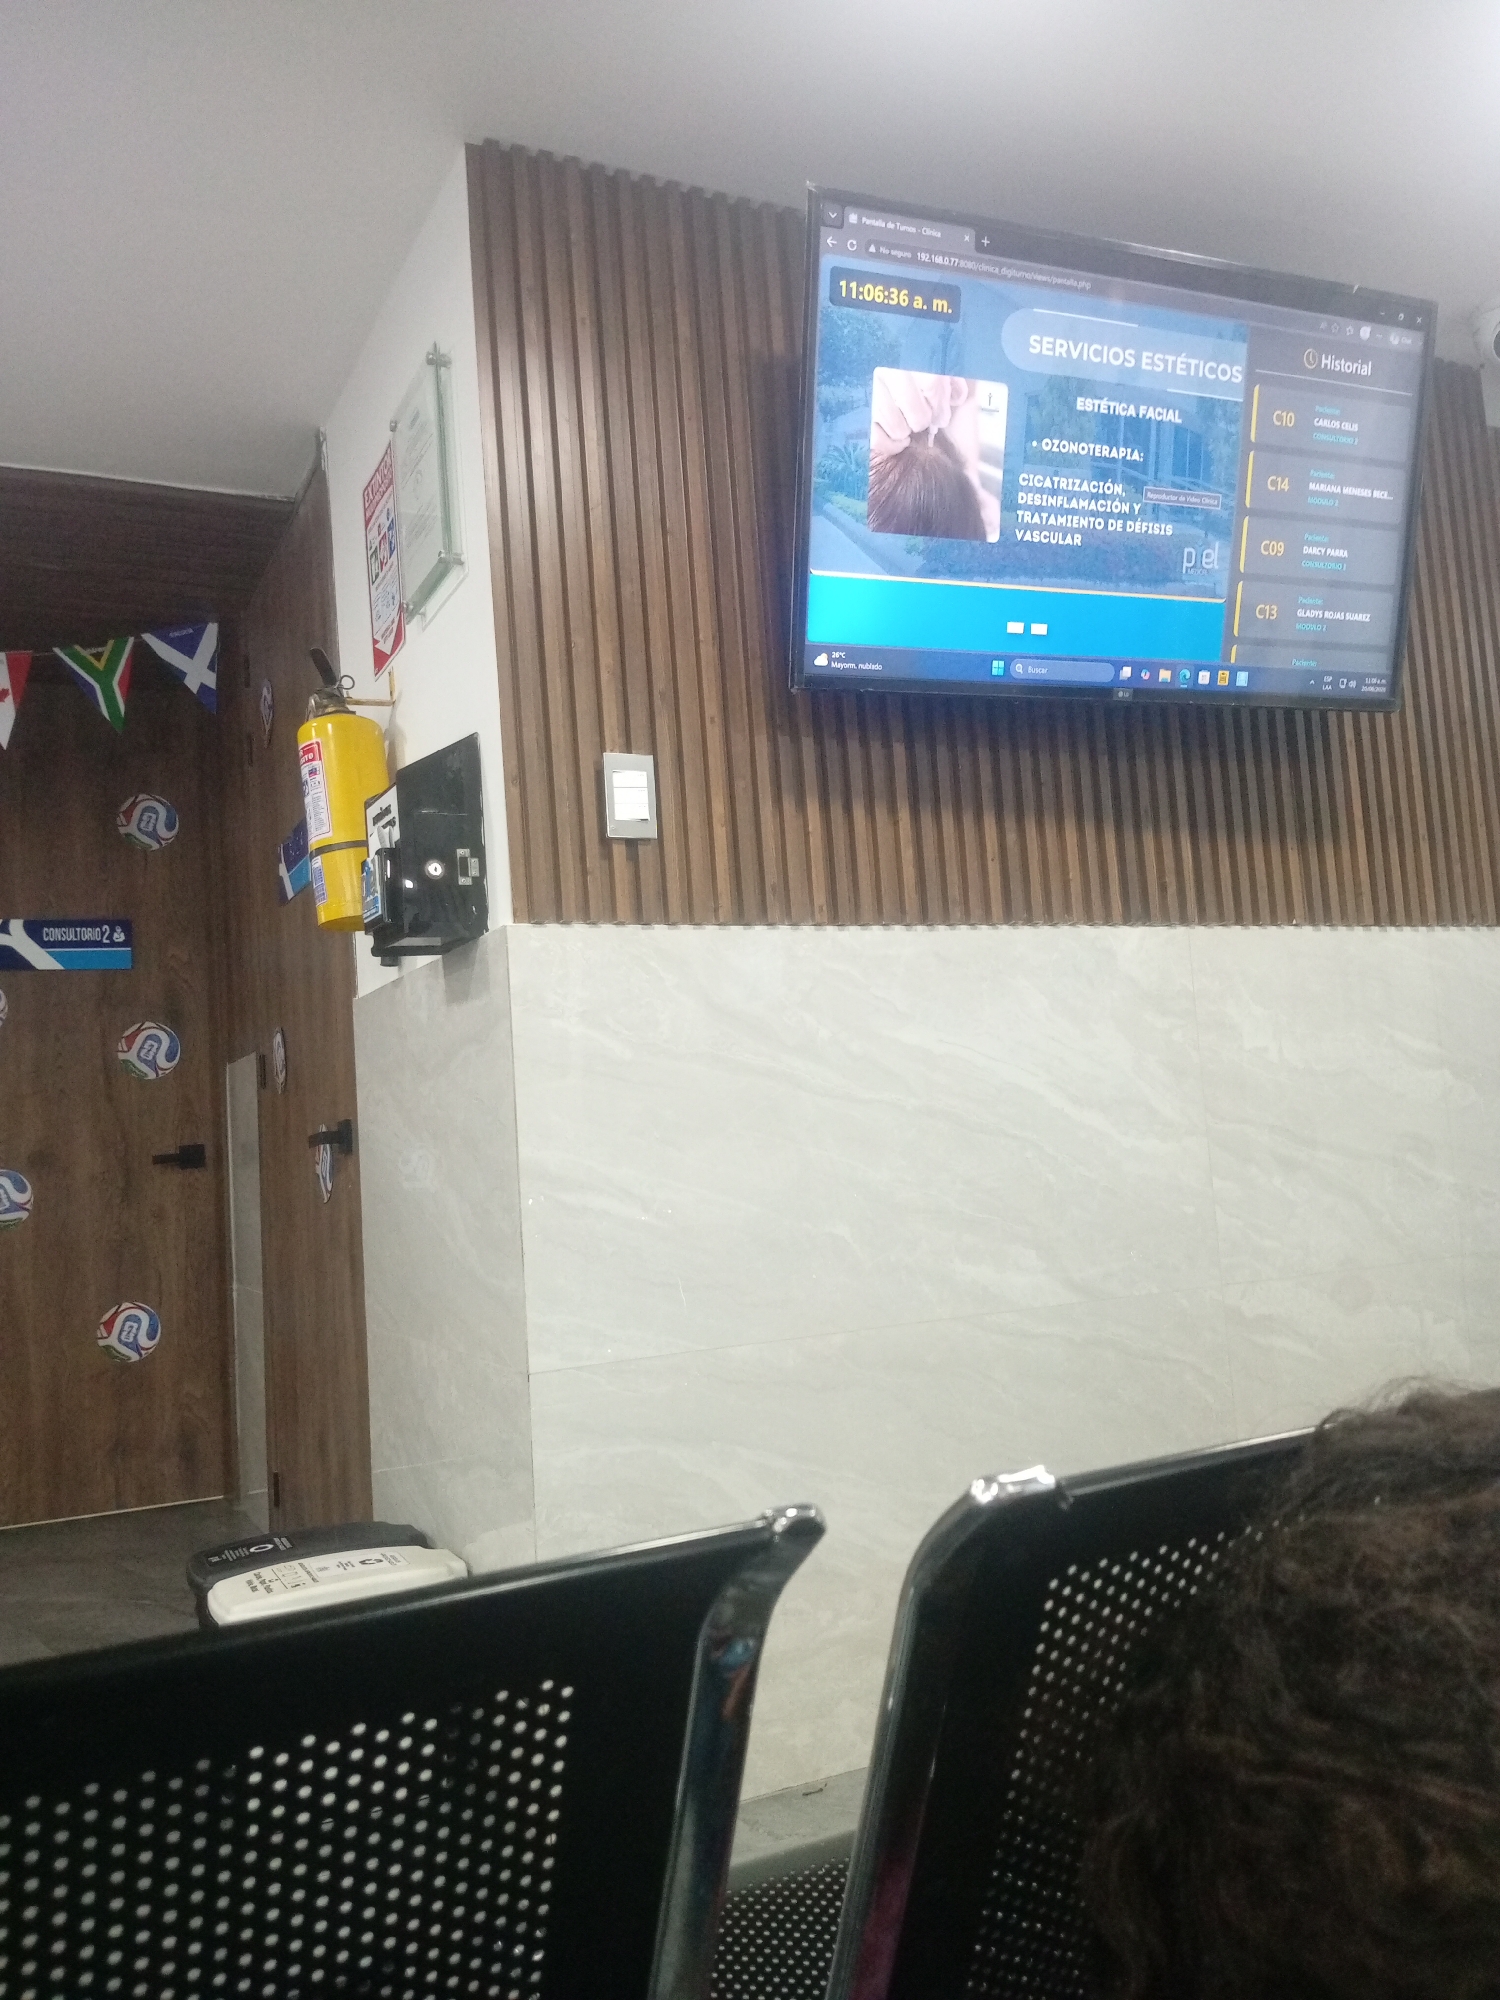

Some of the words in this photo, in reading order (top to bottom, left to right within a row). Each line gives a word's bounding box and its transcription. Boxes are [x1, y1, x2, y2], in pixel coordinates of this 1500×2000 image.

[862, 216, 886, 228] Pantalla
[886, 220, 894, 229] de
[896, 222, 916, 233] Turnos
[880, 246, 890, 254] No
[838, 280, 909, 307] 11:06:36
[1028, 334, 1136, 368] SERVICIOS
[1141, 352, 1242, 384] ESTÉTICOS
[1321, 354, 1372, 376] Historial
[1076, 396, 1136, 416] ESTÉTICA
[1139, 405, 1182, 424] FACIAL
[1272, 410, 1295, 428] C10
[1314, 418, 1340, 430] CARLOS
[1341, 420, 1358, 432] CELIS
[1042, 438, 1144, 462] OZONOTERAPIA:
[1018, 473, 1126, 497] CICATRIZACIÓN,
[1267, 475, 1290, 492] C14
[1308, 482, 1342, 494] MARIANA
[1342, 486, 1372, 498] MENESES
[1018, 492, 1130, 514] DESINFLAMACIÓN
[1132, 503, 1142, 515] Y
[1016, 510, 1105, 530] TRATAMIENTO
[1107, 518, 1123, 532] DE
[1126, 516, 1173, 536] DÉFISIS
[1015, 529, 1082, 546] VASCULAR
[1260, 540, 1284, 556] C09
[1302, 546, 1326, 556] DARCY
[1326, 548, 1348, 558] PARRA
[1256, 604, 1278, 620] C13
[1296, 608, 1323, 618] GLADYS
[1324, 610, 1345, 620] ROJAS
[1345, 612, 1372, 622] SUAREZ
[832, 651, 846, 659] 26°C
[830, 661, 858, 670] Mayorm.
[858, 662, 883, 671] nublado
[1028, 666, 1048, 675] Buscar
[42, 926, 101, 942] CONSULTORIO
[102, 924, 110, 944] 2
